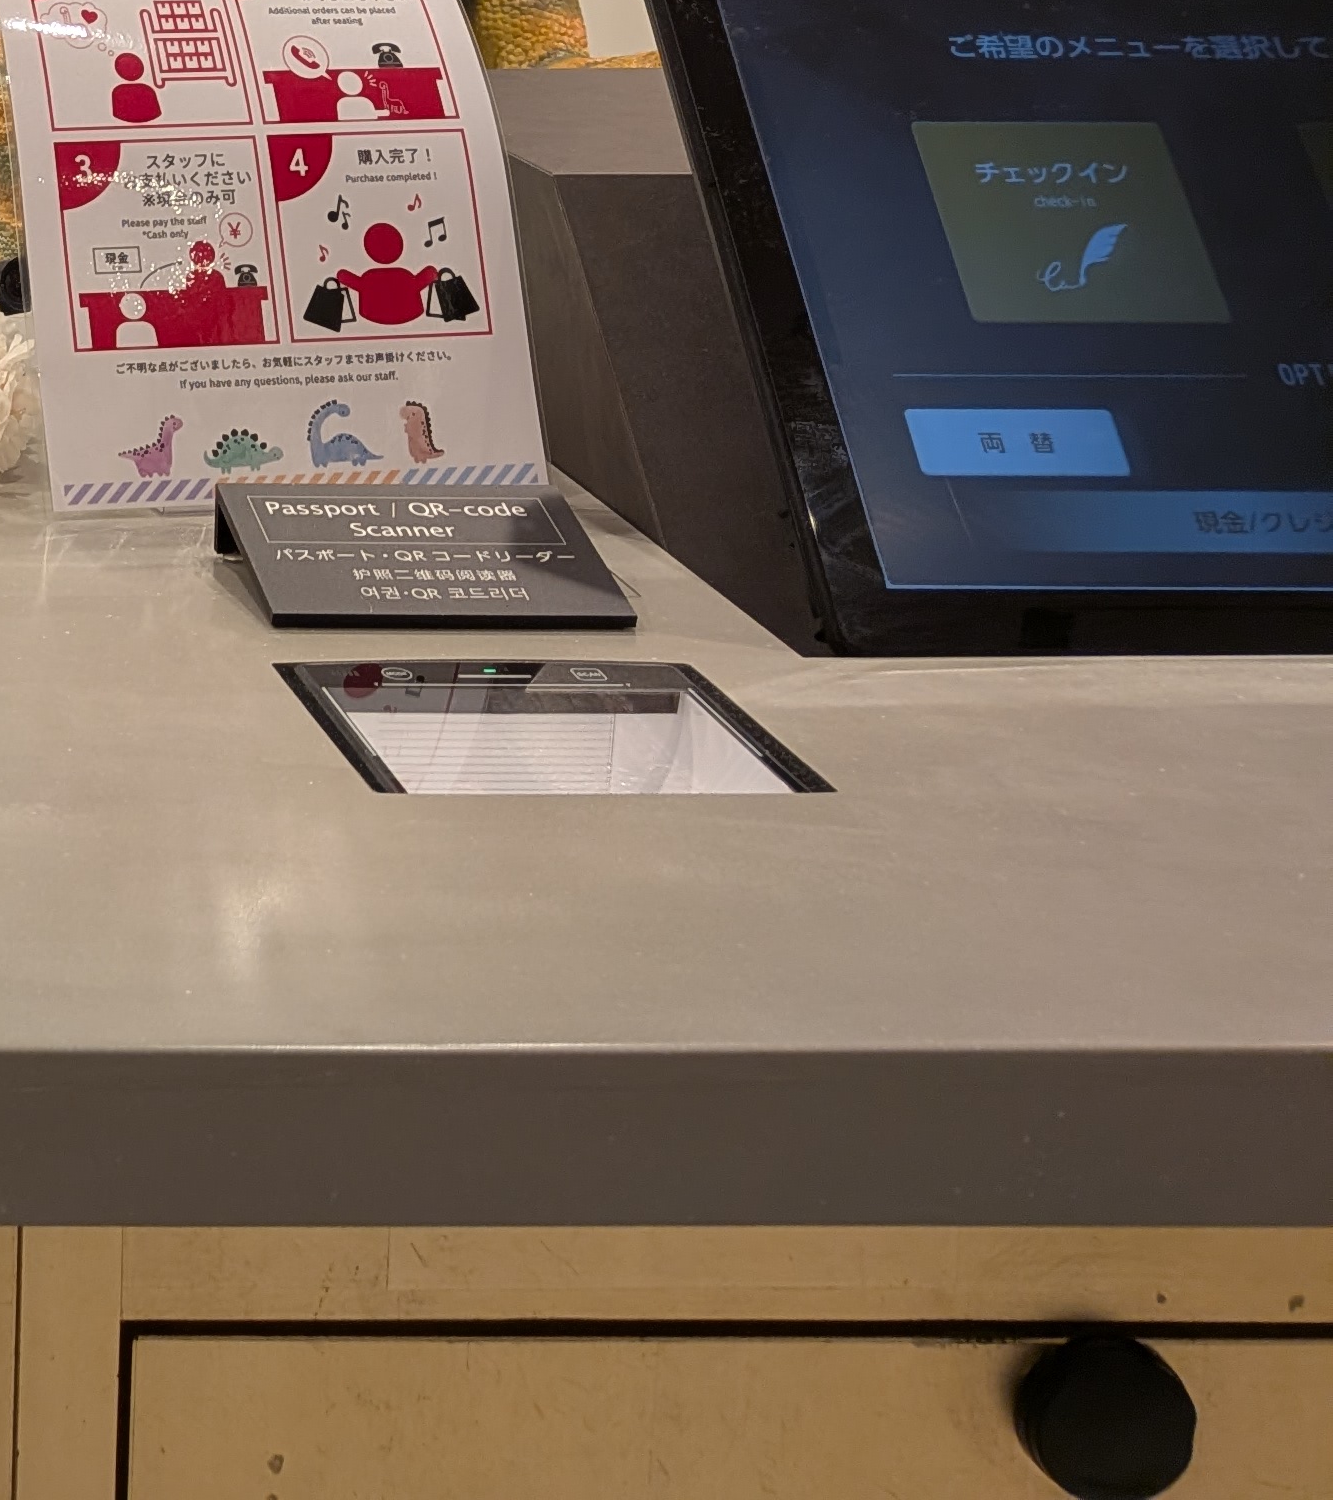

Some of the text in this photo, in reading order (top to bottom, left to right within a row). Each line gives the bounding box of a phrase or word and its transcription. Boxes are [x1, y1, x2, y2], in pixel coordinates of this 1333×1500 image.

[312, 6, 338, 14] orders
[356, 6, 366, 14] be
[369, 6, 395, 14] placed
[332, 17, 363, 25] seating
[948, 33, 1331, 60] ご希望のメニューを選択して
[146, 152, 225, 169] スタッフに
[288, 148, 309, 176] 4
[357, 149, 431, 165] 購入完了！
[75, 154, 92, 178] 3
[974, 161, 1128, 186] チェックイン
[346, 174, 383, 182] Purchase
[386, 172, 431, 182] completed
[121, 216, 206, 227] Please pay the staff
[105, 252, 129, 264] 現金
[179, 371, 398, 390] If you have any questions, please ask our staff.
[266, 501, 379, 518] Passport
[349, 522, 455, 538] Scanner
[352, 569, 517, 582] 护照二维码阅读器
[449, 586, 530, 601] 코드리더
